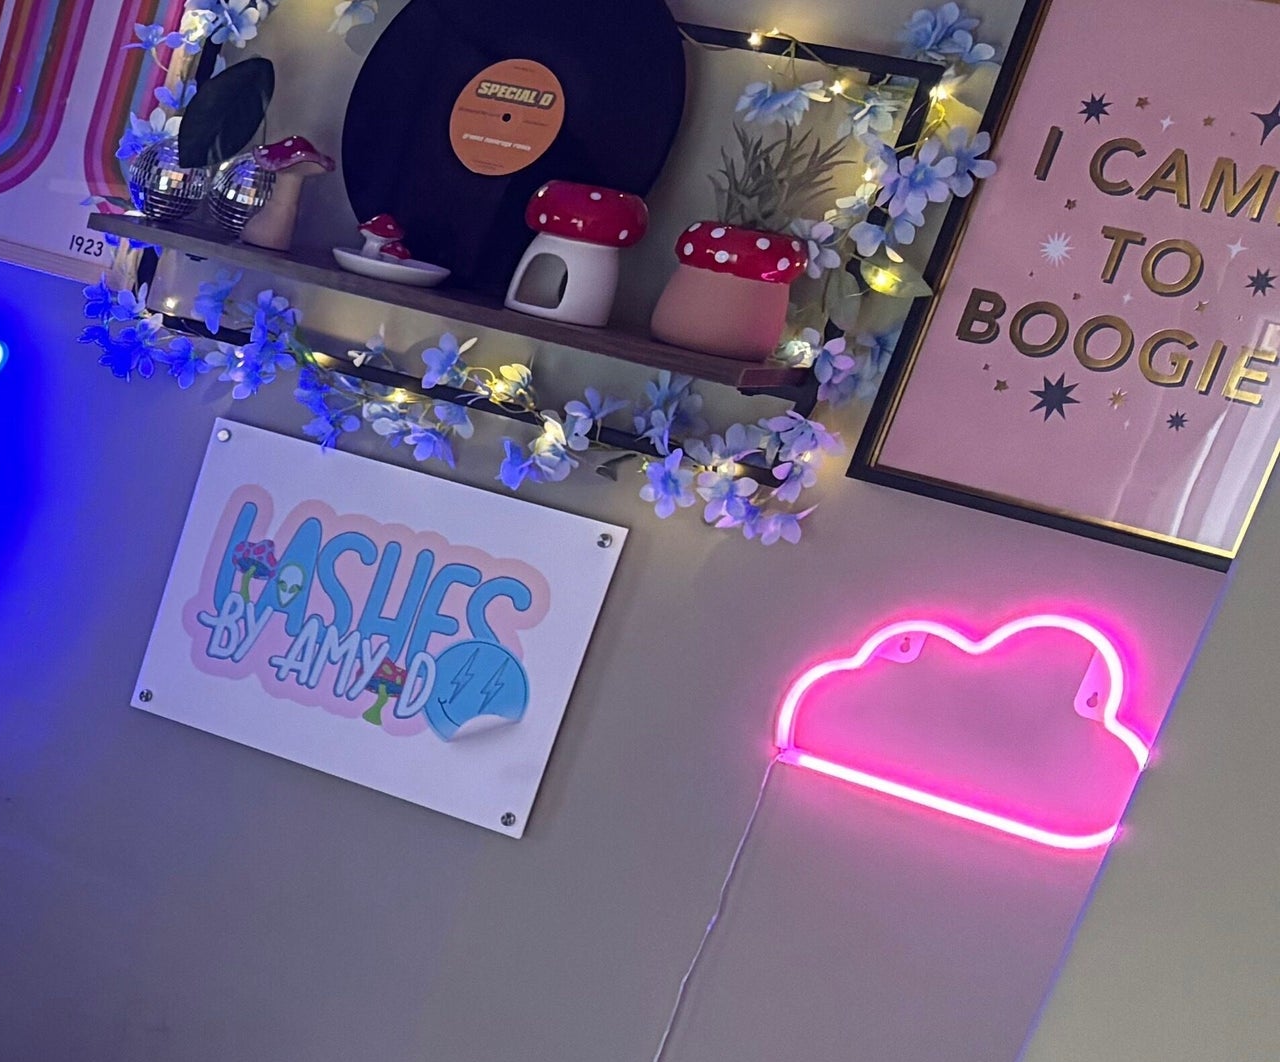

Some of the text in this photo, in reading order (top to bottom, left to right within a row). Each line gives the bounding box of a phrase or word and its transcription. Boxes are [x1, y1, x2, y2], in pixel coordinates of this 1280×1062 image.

[477, 81, 539, 104] SPECIAL
[1033, 125, 1280, 226] I CAM
[69, 234, 104, 257] 1923
[1100, 225, 1204, 297] TO
[955, 287, 1278, 406] BOOGIE
[213, 501, 532, 668] LASHES
[196, 591, 436, 719] BY AMY D
